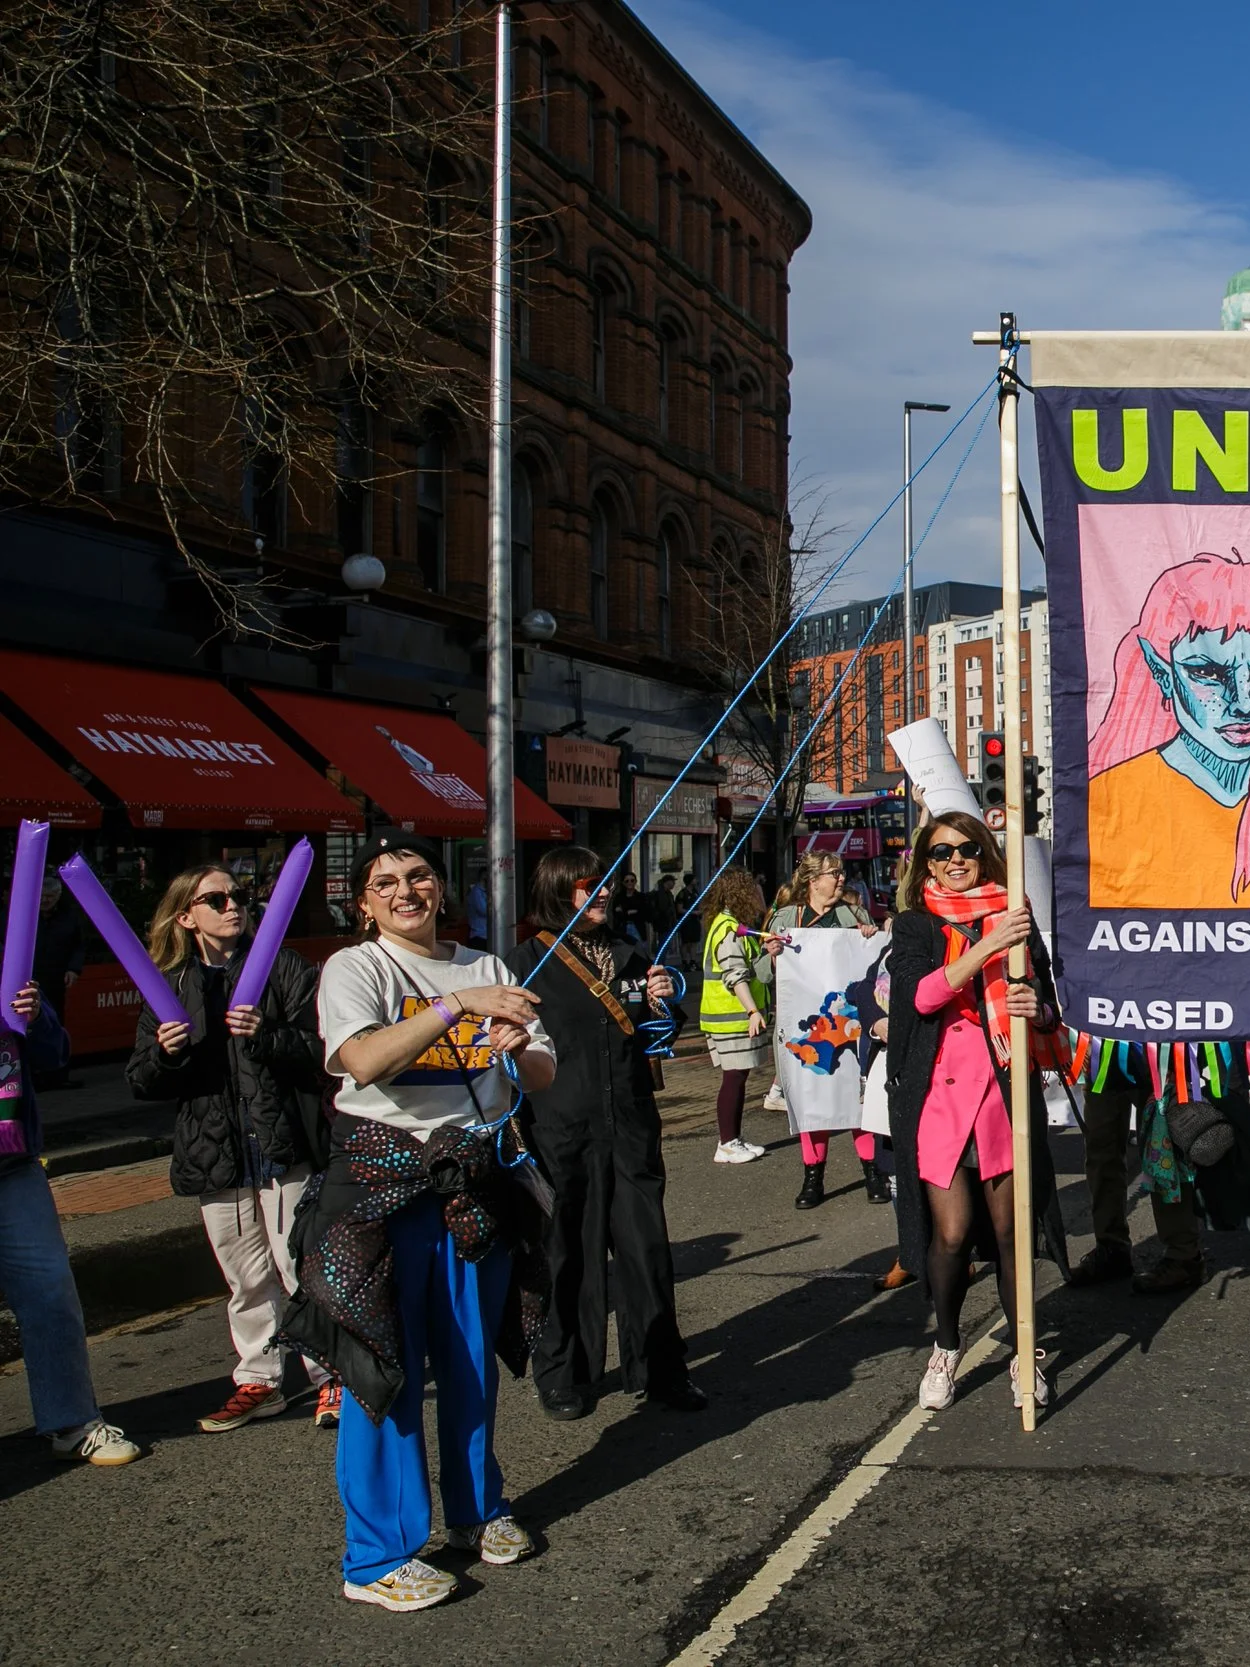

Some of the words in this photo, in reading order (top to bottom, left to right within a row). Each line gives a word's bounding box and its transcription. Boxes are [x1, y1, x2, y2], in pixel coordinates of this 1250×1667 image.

[137, 714, 178, 728] STREET
[180, 720, 211, 733] FOOD
[77, 726, 275, 766] HAYMARKET
[548, 760, 619, 788] HAYMARKET
[850, 837, 864, 846] ZERO
[97, 989, 143, 1008] HAYMA
[1087, 996, 1235, 1032] BASED
